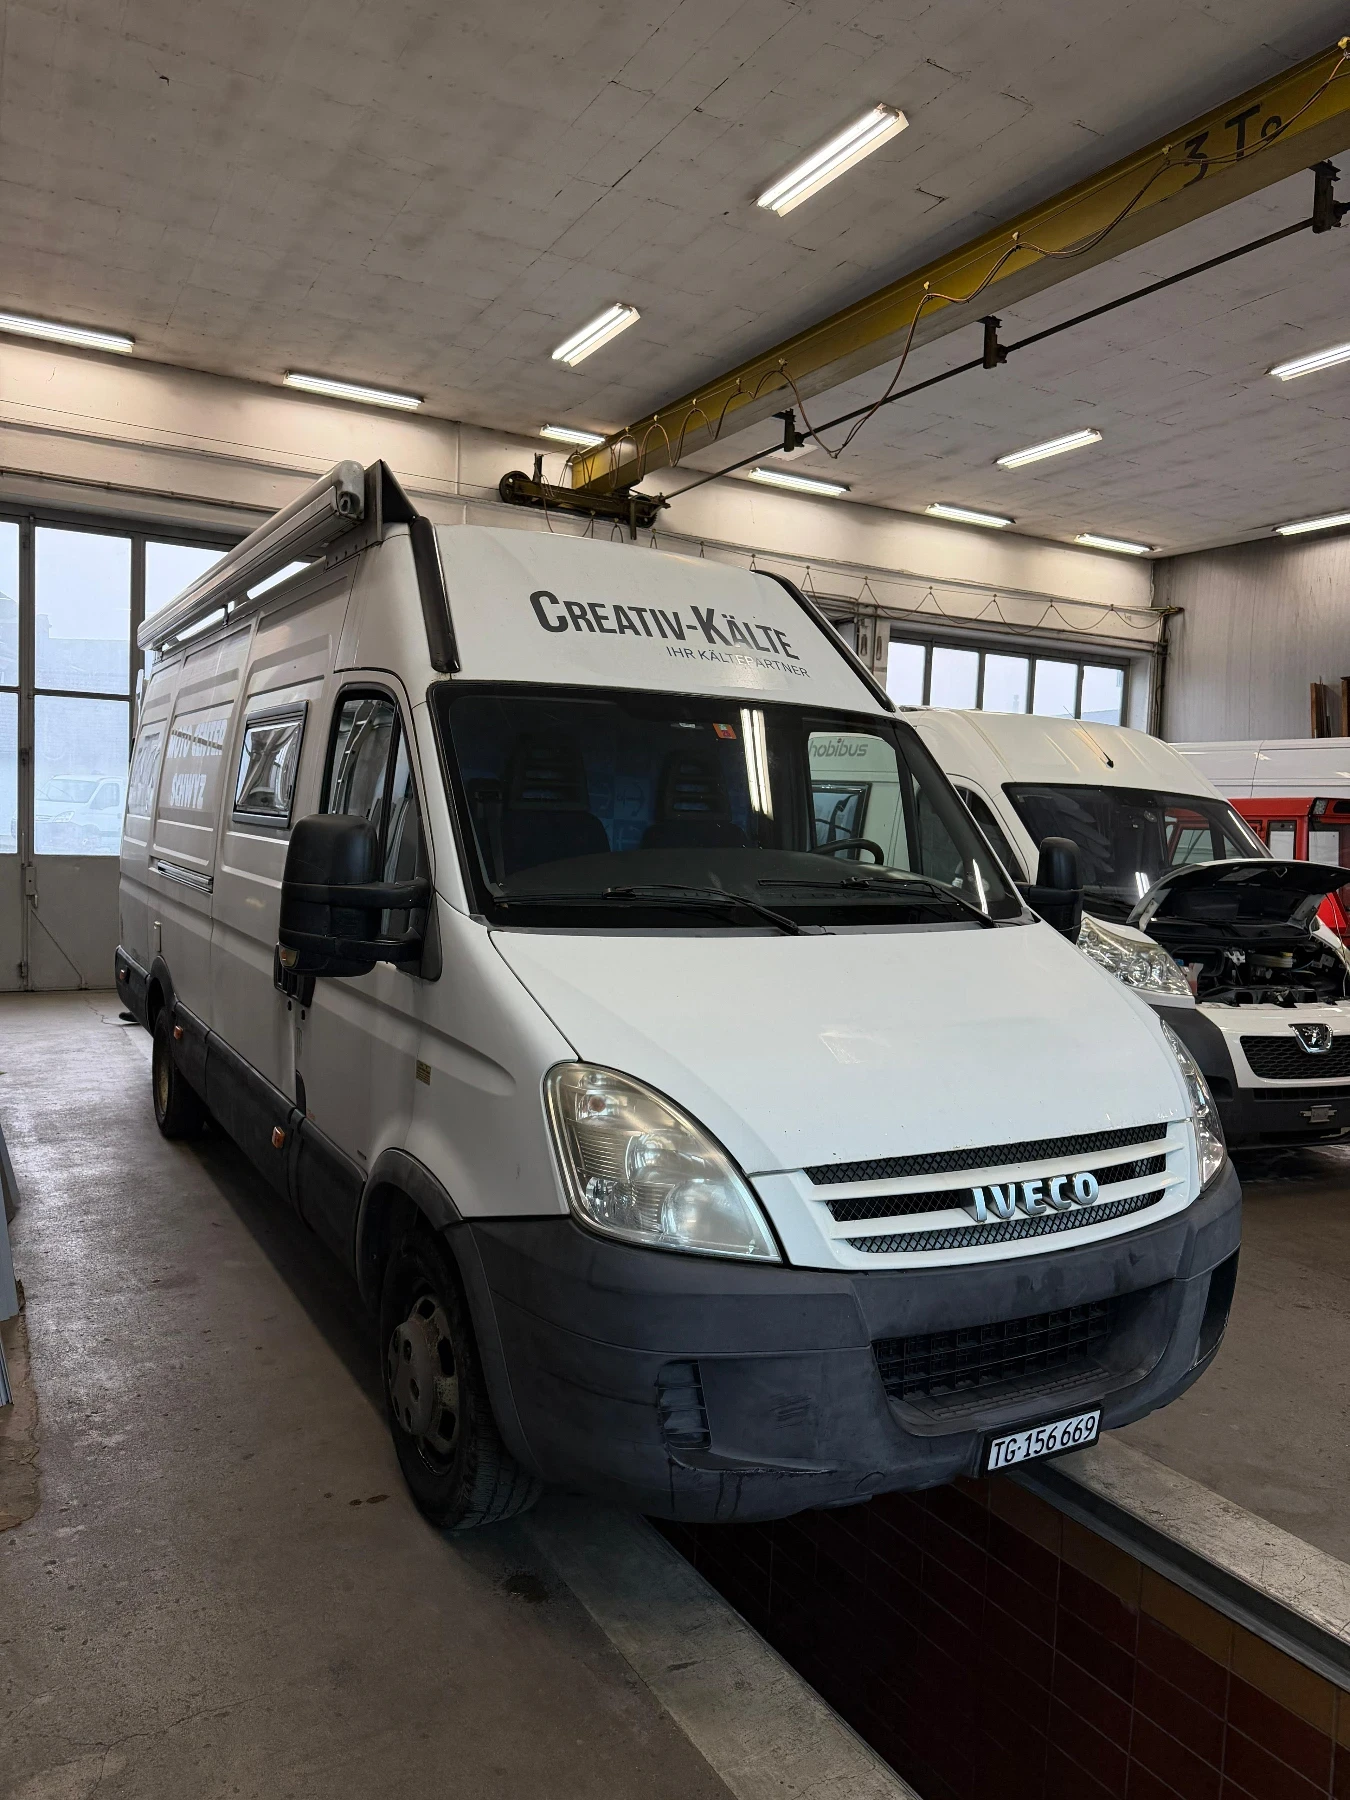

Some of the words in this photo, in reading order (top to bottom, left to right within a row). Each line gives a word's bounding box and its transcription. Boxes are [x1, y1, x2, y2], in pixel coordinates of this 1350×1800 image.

[1184, 131, 1209, 188] 3
[529, 590, 801, 660] CREATIV-KÄLTE
[666, 646, 696, 660] IHR
[699, 648, 811, 678] KÄLTEPARTNER
[808, 738, 869, 757] hobibus
[170, 773, 207, 810] SCHWYZ
[968, 1171, 1099, 1224] IVECO
